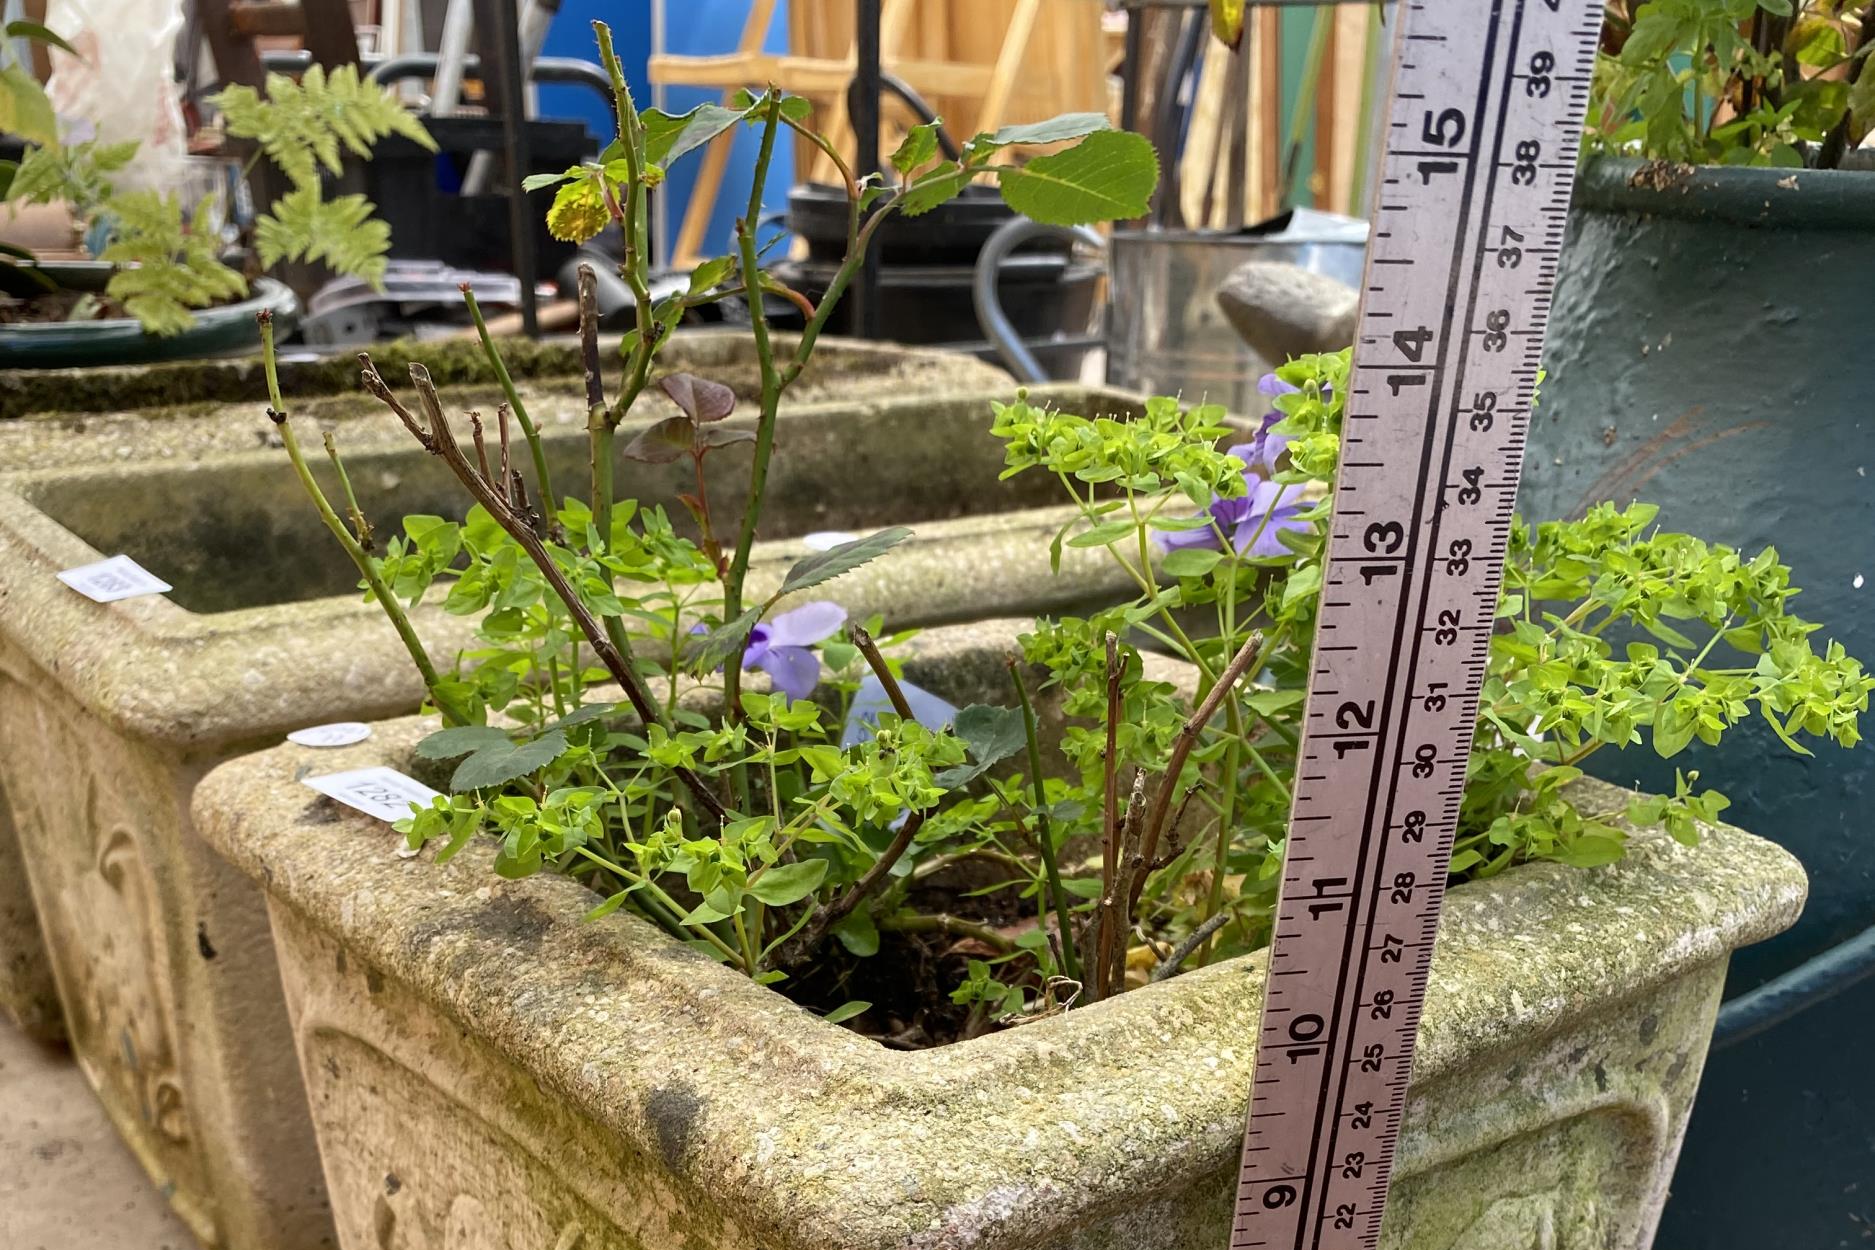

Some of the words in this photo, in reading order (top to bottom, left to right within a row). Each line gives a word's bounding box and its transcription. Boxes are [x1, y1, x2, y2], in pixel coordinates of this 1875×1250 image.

[1526, 51, 1555, 98] 39
[1418, 108, 1466, 185] 15
[1512, 139, 1541, 186] 38
[1497, 225, 1525, 268] 37
[1483, 309, 1511, 352] 36
[1387, 326, 1434, 396] 14
[1469, 392, 1497, 433] 35
[1458, 466, 1485, 505] 34
[1360, 521, 1404, 586] 13
[1446, 538, 1473, 576] 33
[1435, 609, 1462, 646] 32
[1424, 682, 1448, 712] 31
[1333, 700, 1376, 759] 12
[1412, 744, 1438, 779] 30
[1402, 811, 1427, 844] 29
[1309, 877, 1348, 921] 11
[1391, 872, 1415, 905] 28
[1381, 934, 1404, 964] 27
[1371, 989, 1395, 1021] 26
[1287, 1014, 1325, 1065] 10
[1361, 1043, 1384, 1073] 25
[1351, 1101, 1374, 1130] 24
[1343, 1151, 1365, 1179] 23
[1263, 1185, 1297, 1209] 9
[1334, 1203, 1357, 1230] 22
